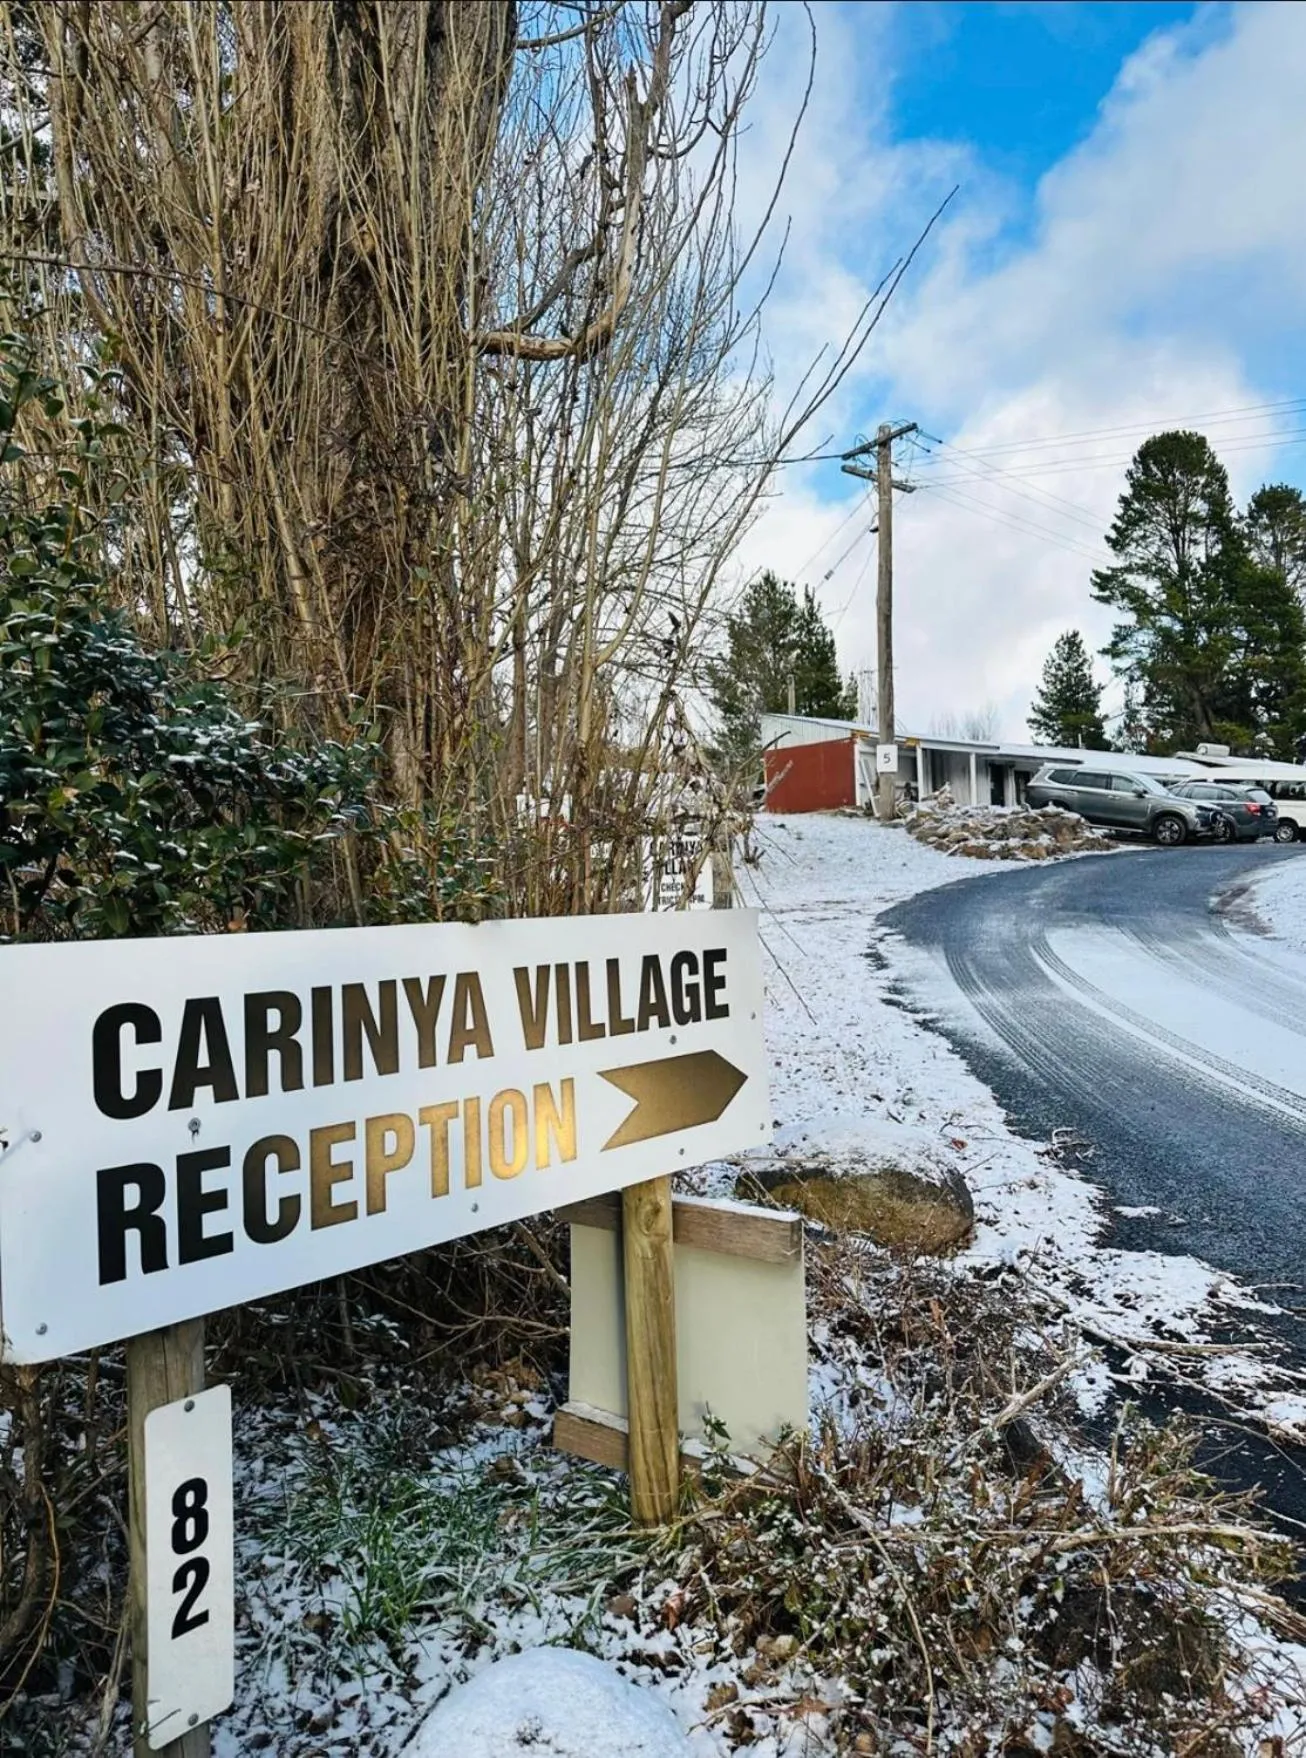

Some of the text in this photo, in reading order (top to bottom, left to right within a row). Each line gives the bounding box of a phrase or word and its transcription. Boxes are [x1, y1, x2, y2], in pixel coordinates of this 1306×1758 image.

[883, 753, 892, 764] 5
[92, 948, 730, 1121] CARINYA VILLAGE
[97, 1077, 577, 1287] RECEPTION
